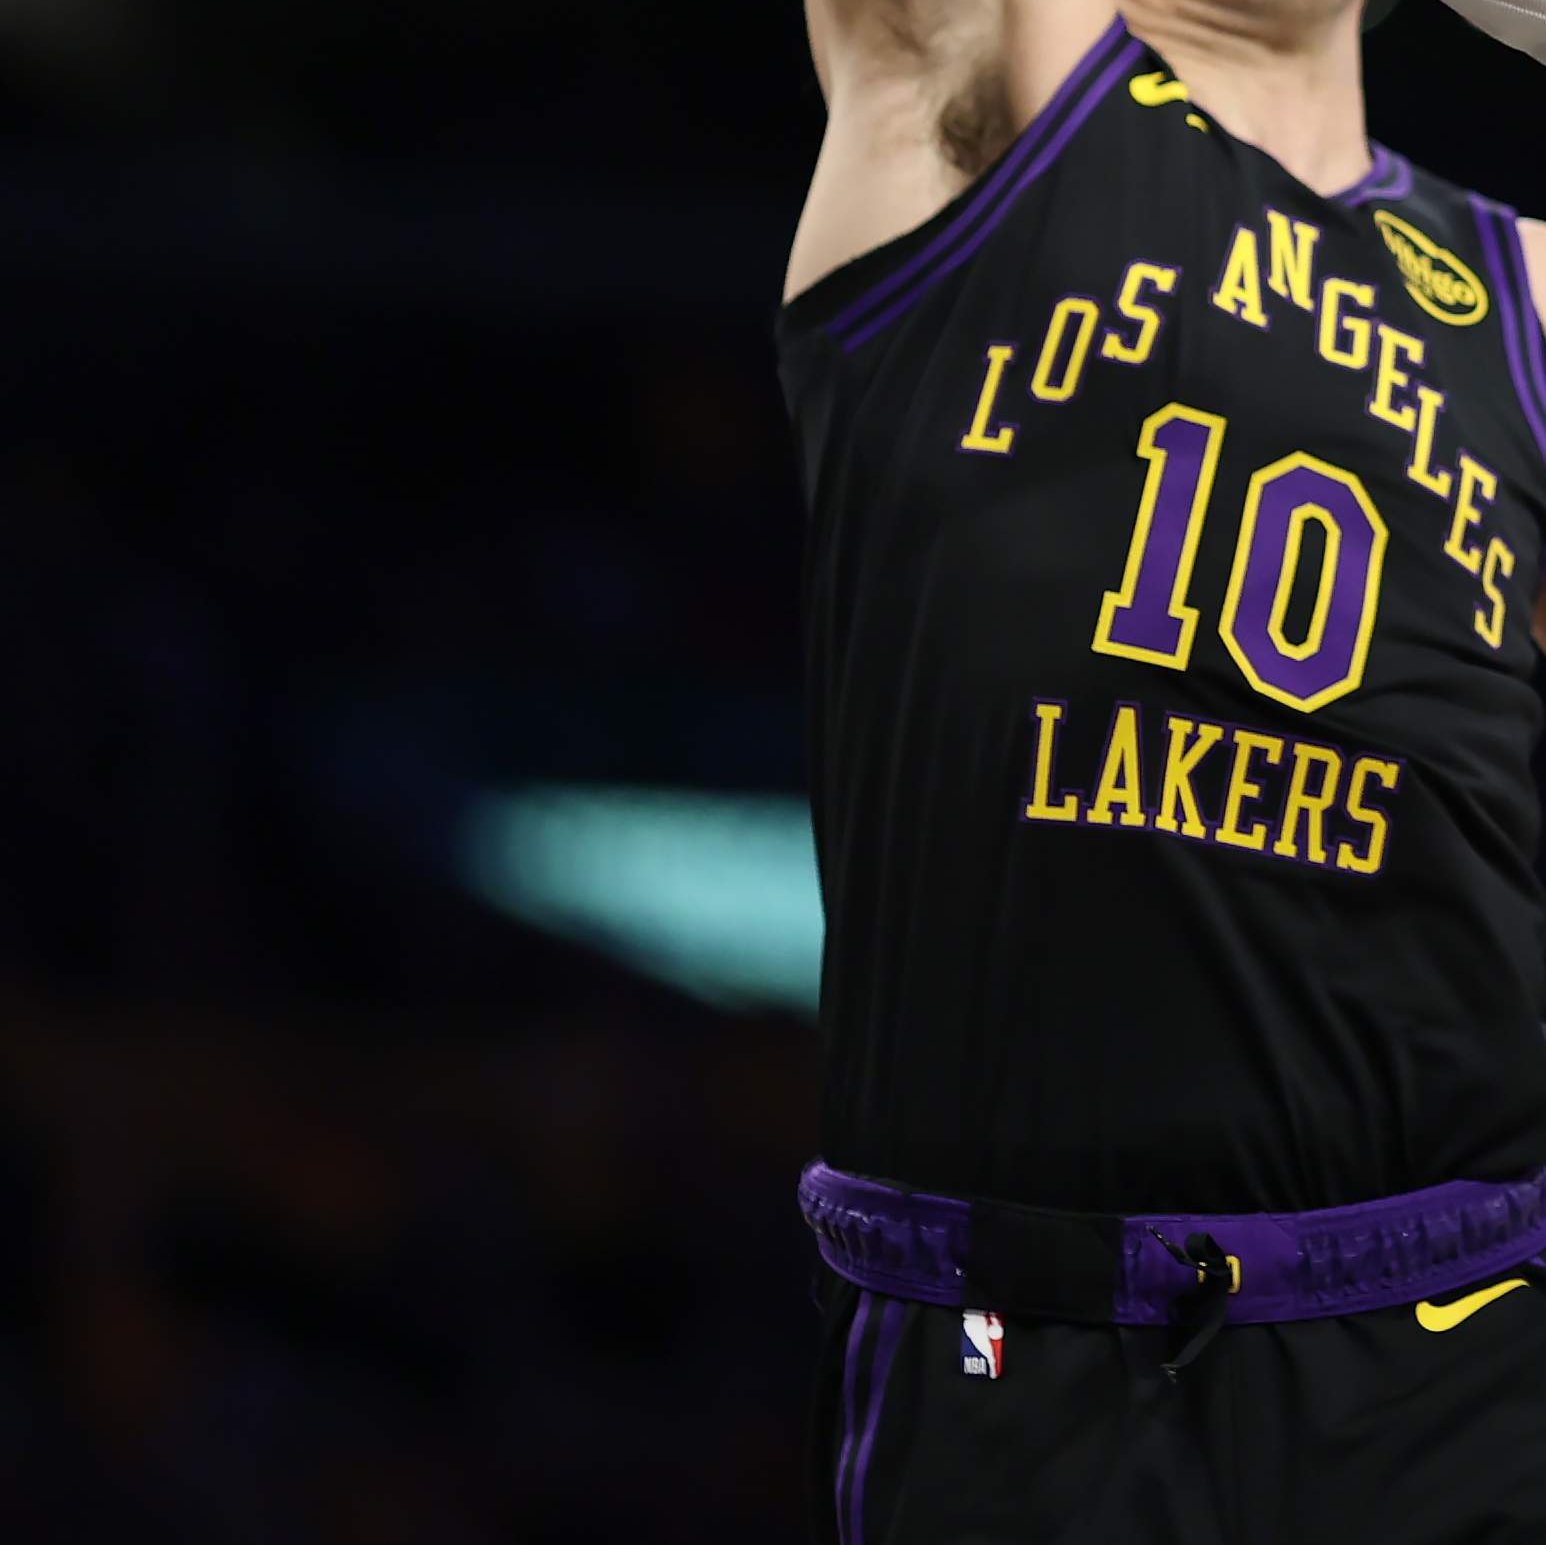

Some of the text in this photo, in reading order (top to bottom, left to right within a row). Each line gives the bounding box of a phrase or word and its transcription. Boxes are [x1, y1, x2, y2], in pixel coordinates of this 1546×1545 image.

[959, 207, 1517, 652] LOS ANGELES
[1090, 400, 1391, 715] 10
[1023, 701, 1401, 877] LAKERS
[963, 1355, 988, 1375] NBA
